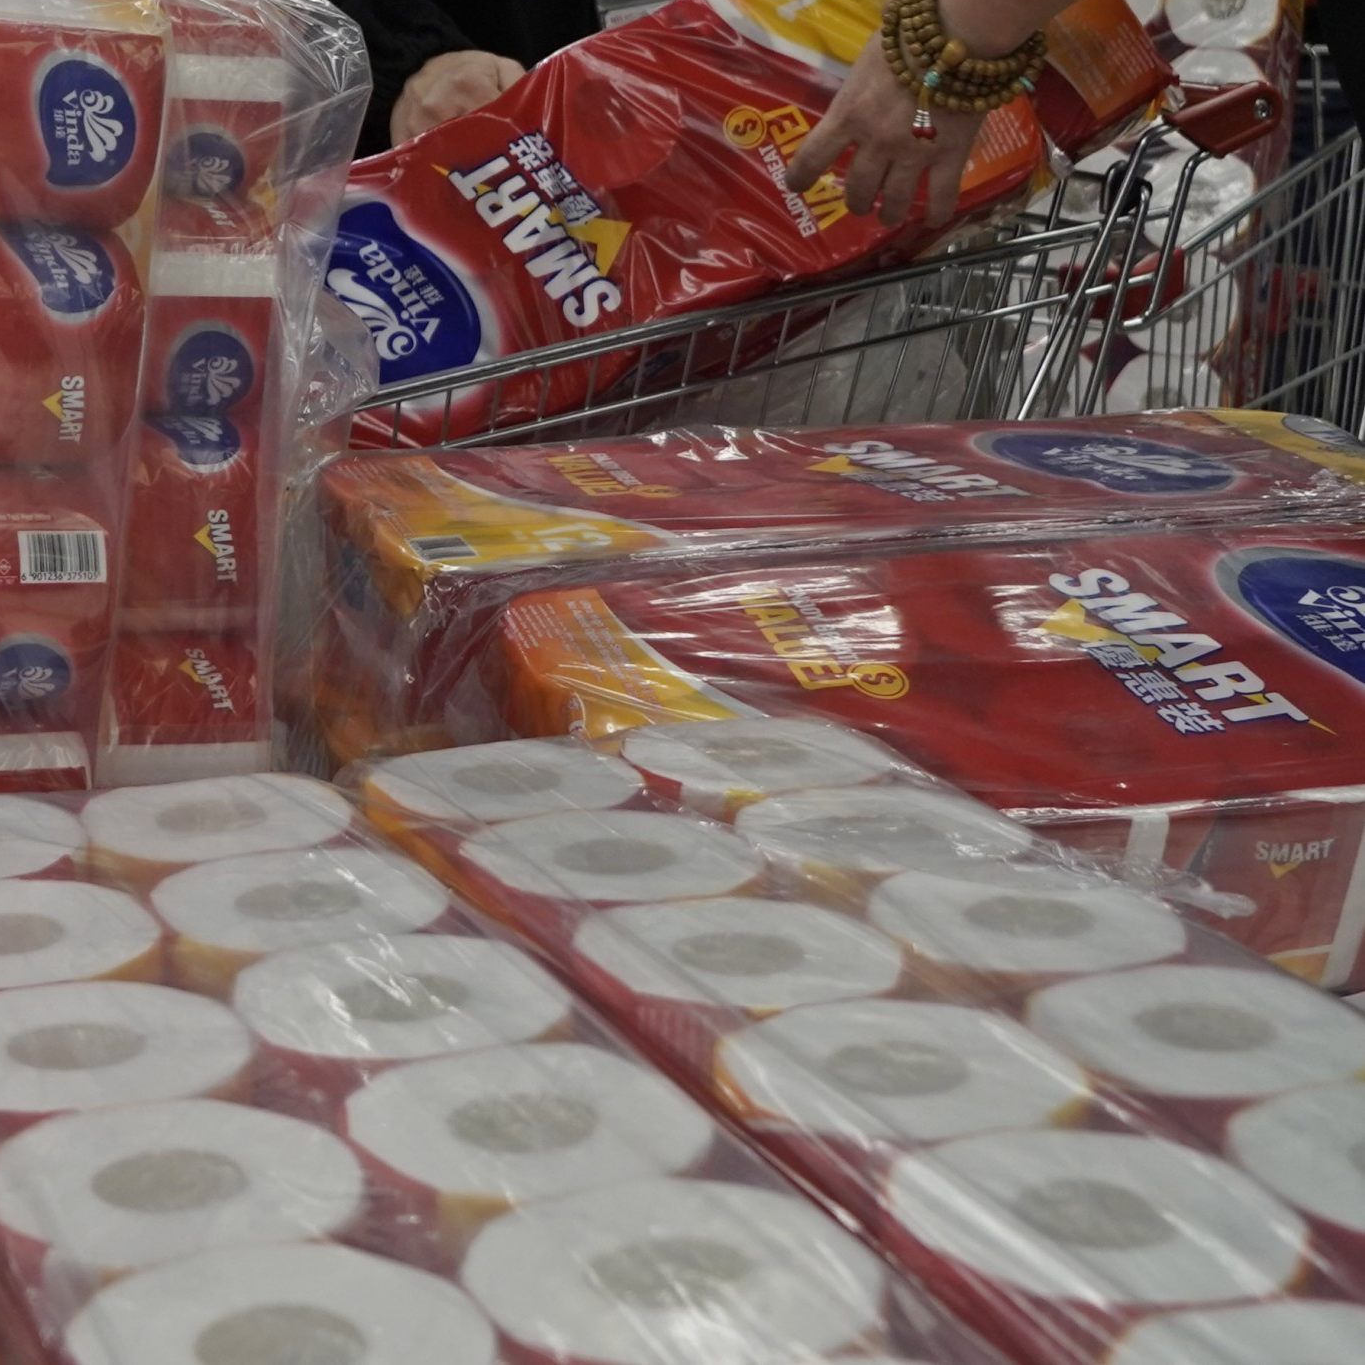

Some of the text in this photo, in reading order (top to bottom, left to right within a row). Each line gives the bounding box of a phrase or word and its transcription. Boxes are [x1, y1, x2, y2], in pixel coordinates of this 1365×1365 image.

[61, 88, 85, 167] Vinda
[509, 131, 602, 226] 優惠裝
[447, 155, 623, 328] SMART
[358, 241, 441, 343] Vinda
[57, 375, 85, 443] SMART
[823, 439, 1032, 499] SMART
[206, 508, 238, 583] SMART
[1046, 567, 1309, 725] SMART
[1297, 588, 1365, 651] Vin
[184, 647, 236, 713] SMART
[1084, 642, 1227, 736] 優惠裝
[1254, 837, 1336, 863] SMART
